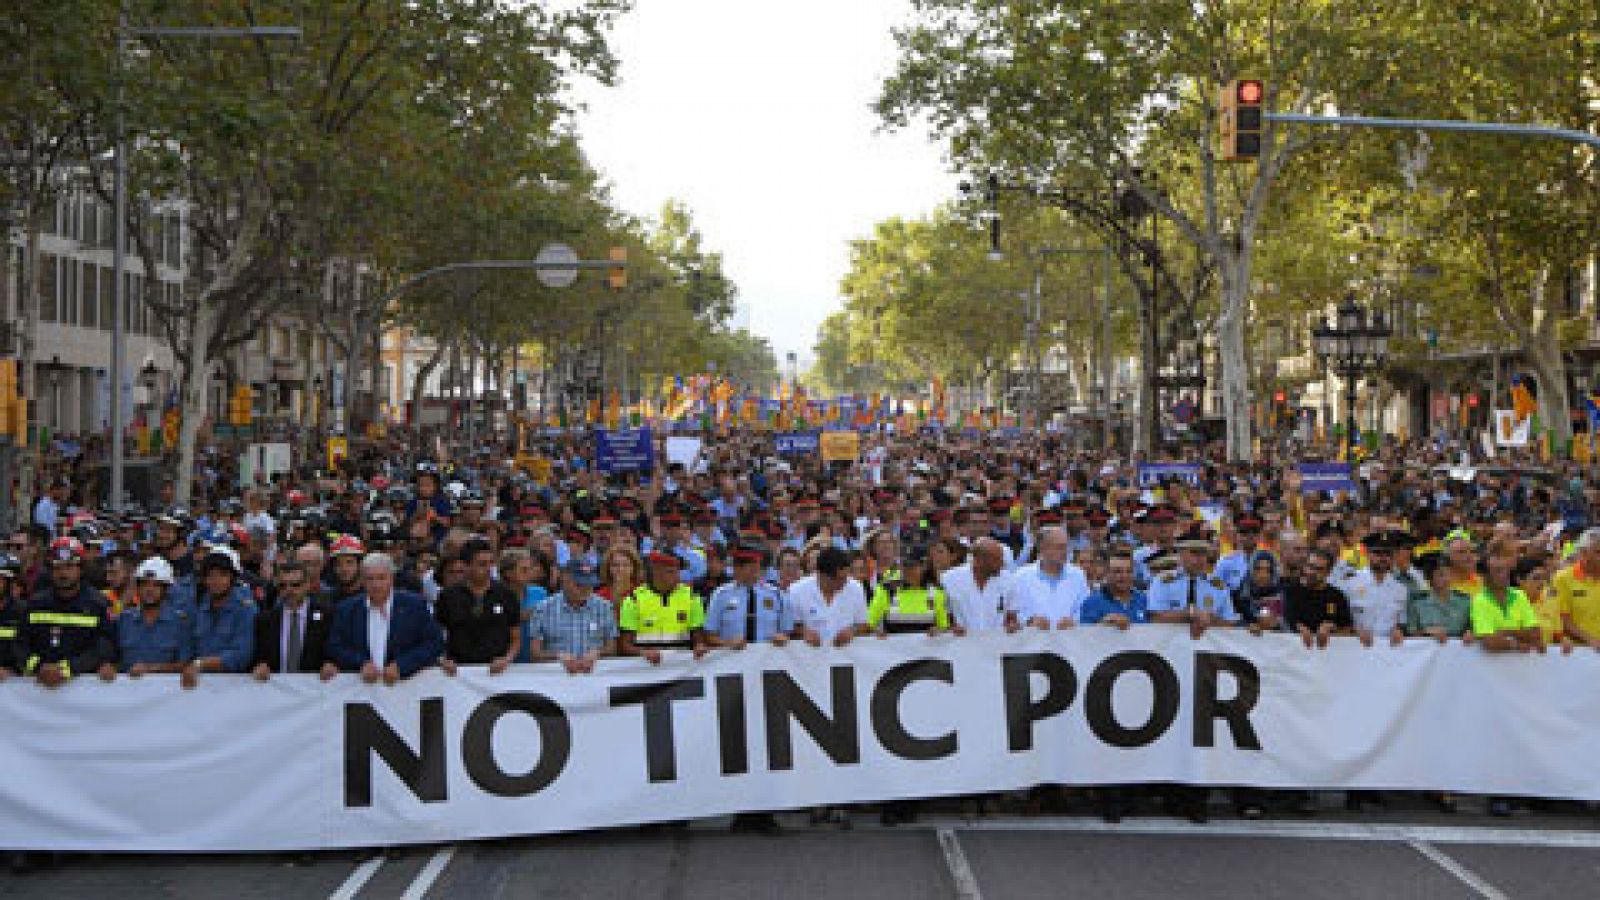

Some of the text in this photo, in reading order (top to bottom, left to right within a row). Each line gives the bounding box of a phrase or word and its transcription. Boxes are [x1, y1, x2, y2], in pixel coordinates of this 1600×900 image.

[343, 649, 1264, 808] NO TINC POR
